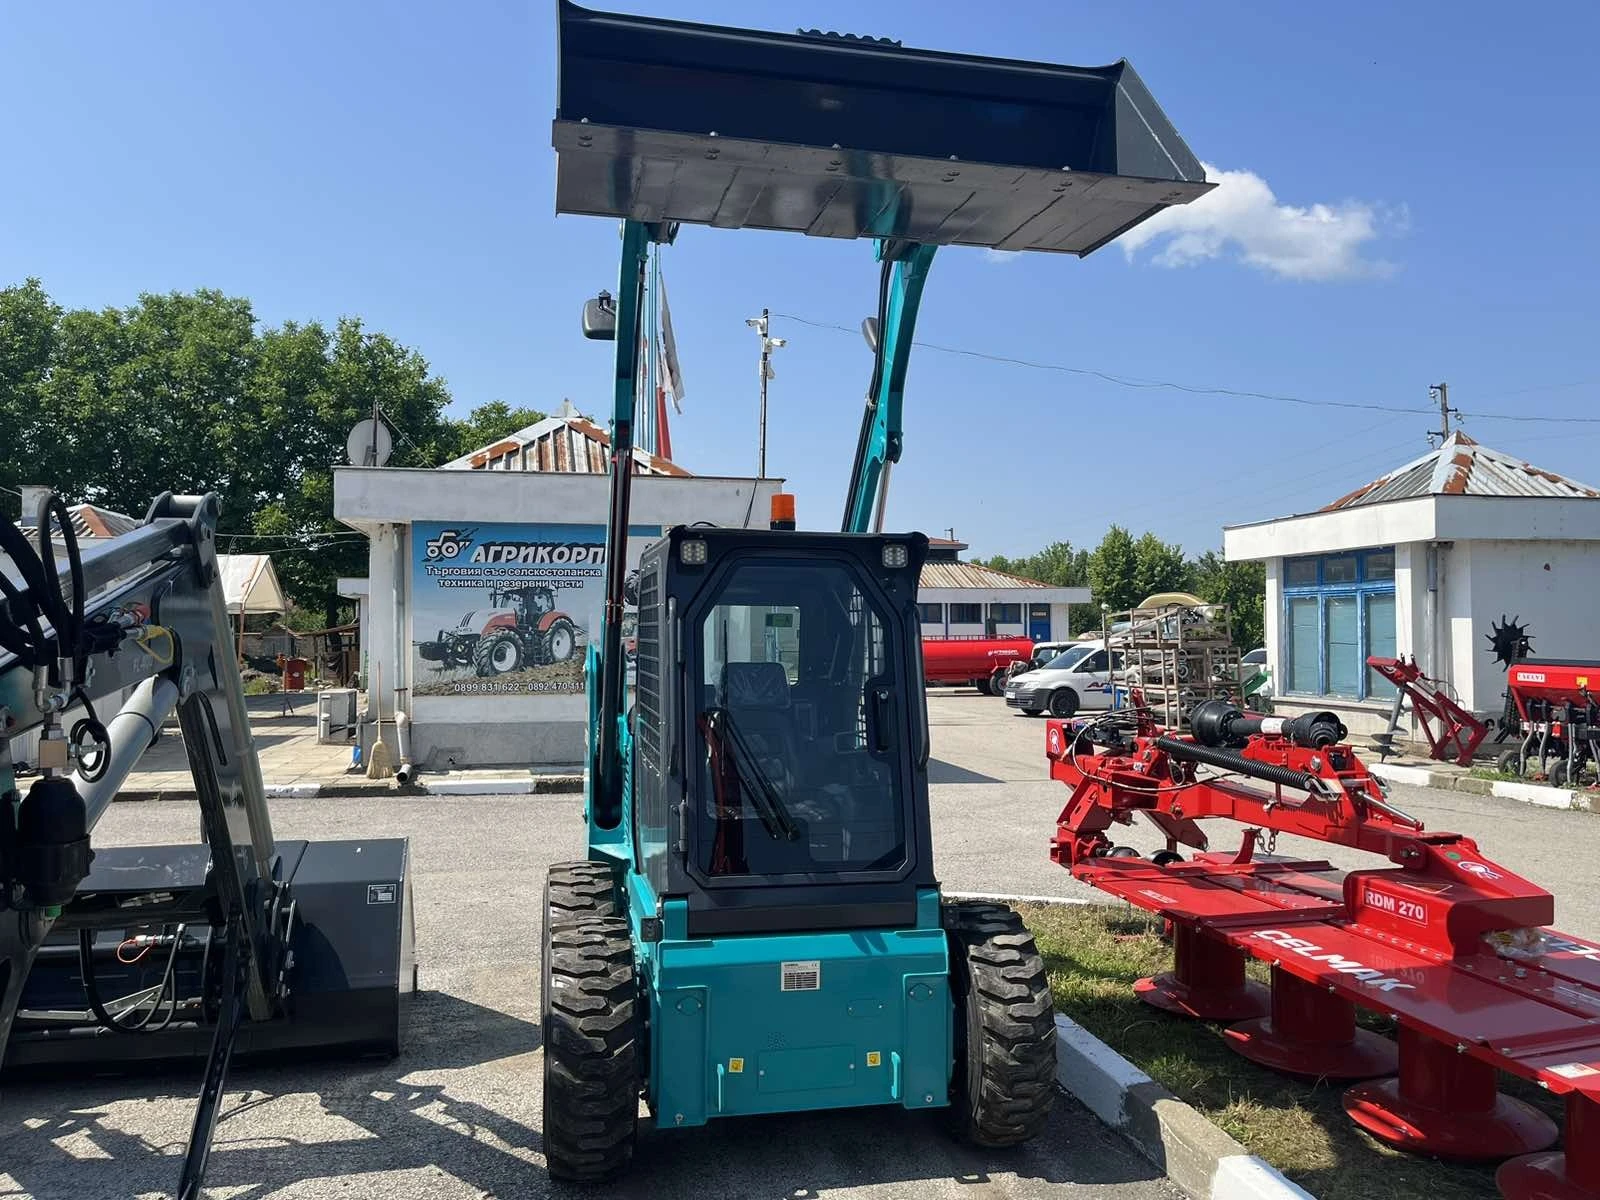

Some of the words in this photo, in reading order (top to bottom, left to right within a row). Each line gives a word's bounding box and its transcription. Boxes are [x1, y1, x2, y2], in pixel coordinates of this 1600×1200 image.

[470, 545, 605, 564] АГРИКОРП
[426, 566, 481, 577] Търговия
[484, 568, 506, 576] със
[507, 568, 602, 577] селскостопанска
[439, 580, 484, 588] техника
[486, 580, 494, 588] и
[495, 580, 550, 590] резервни
[551, 580, 584, 588] части
[454, 683, 479, 692] 0899
[481, 683, 499, 692] 831
[502, 683, 520, 691] 622
[528, 682, 549, 691] 0892
[551, 682, 568, 690] 470
[1366, 890, 1395, 911] RDM
[1398, 901, 1425, 920] 270
